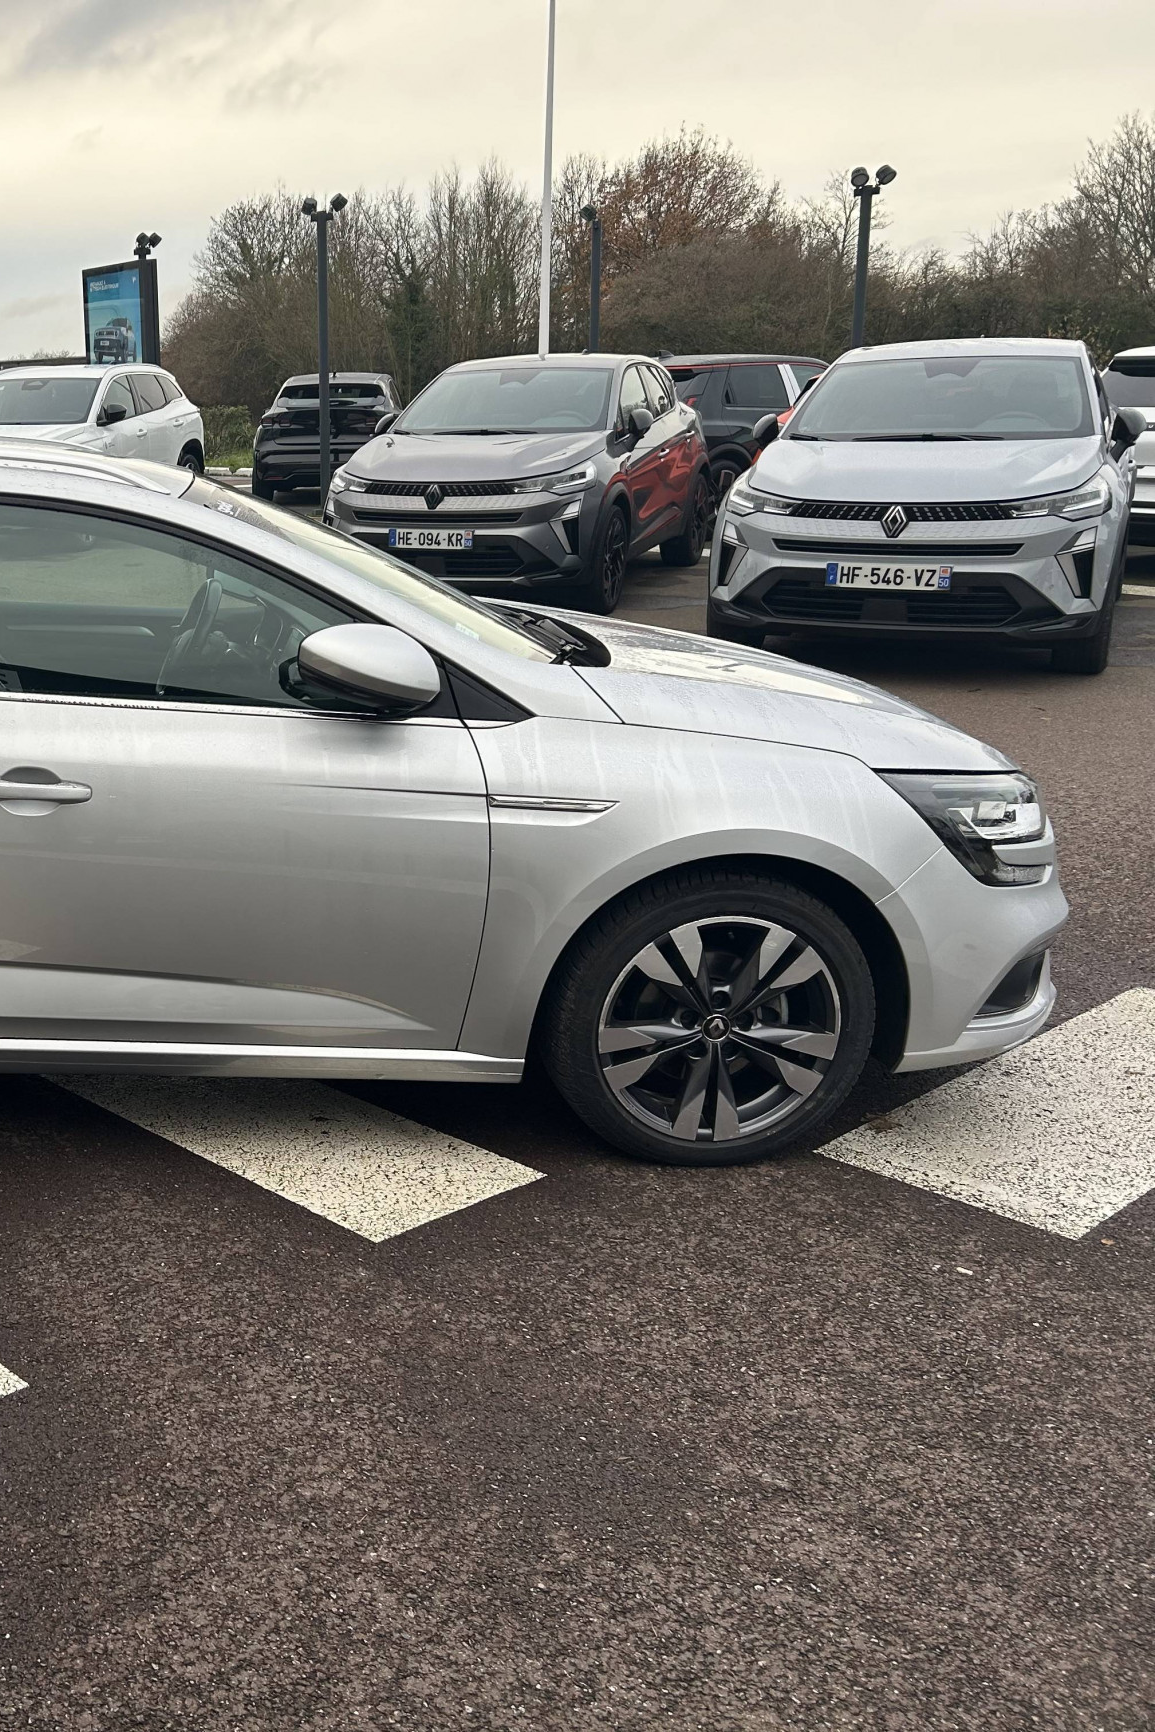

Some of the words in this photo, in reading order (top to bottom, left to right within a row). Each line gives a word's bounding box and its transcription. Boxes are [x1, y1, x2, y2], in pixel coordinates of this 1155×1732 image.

[397, 531, 463, 547] HE-094-KR
[839, 566, 937, 587] HF-546-VZ
[938, 578, 949, 587] 50
